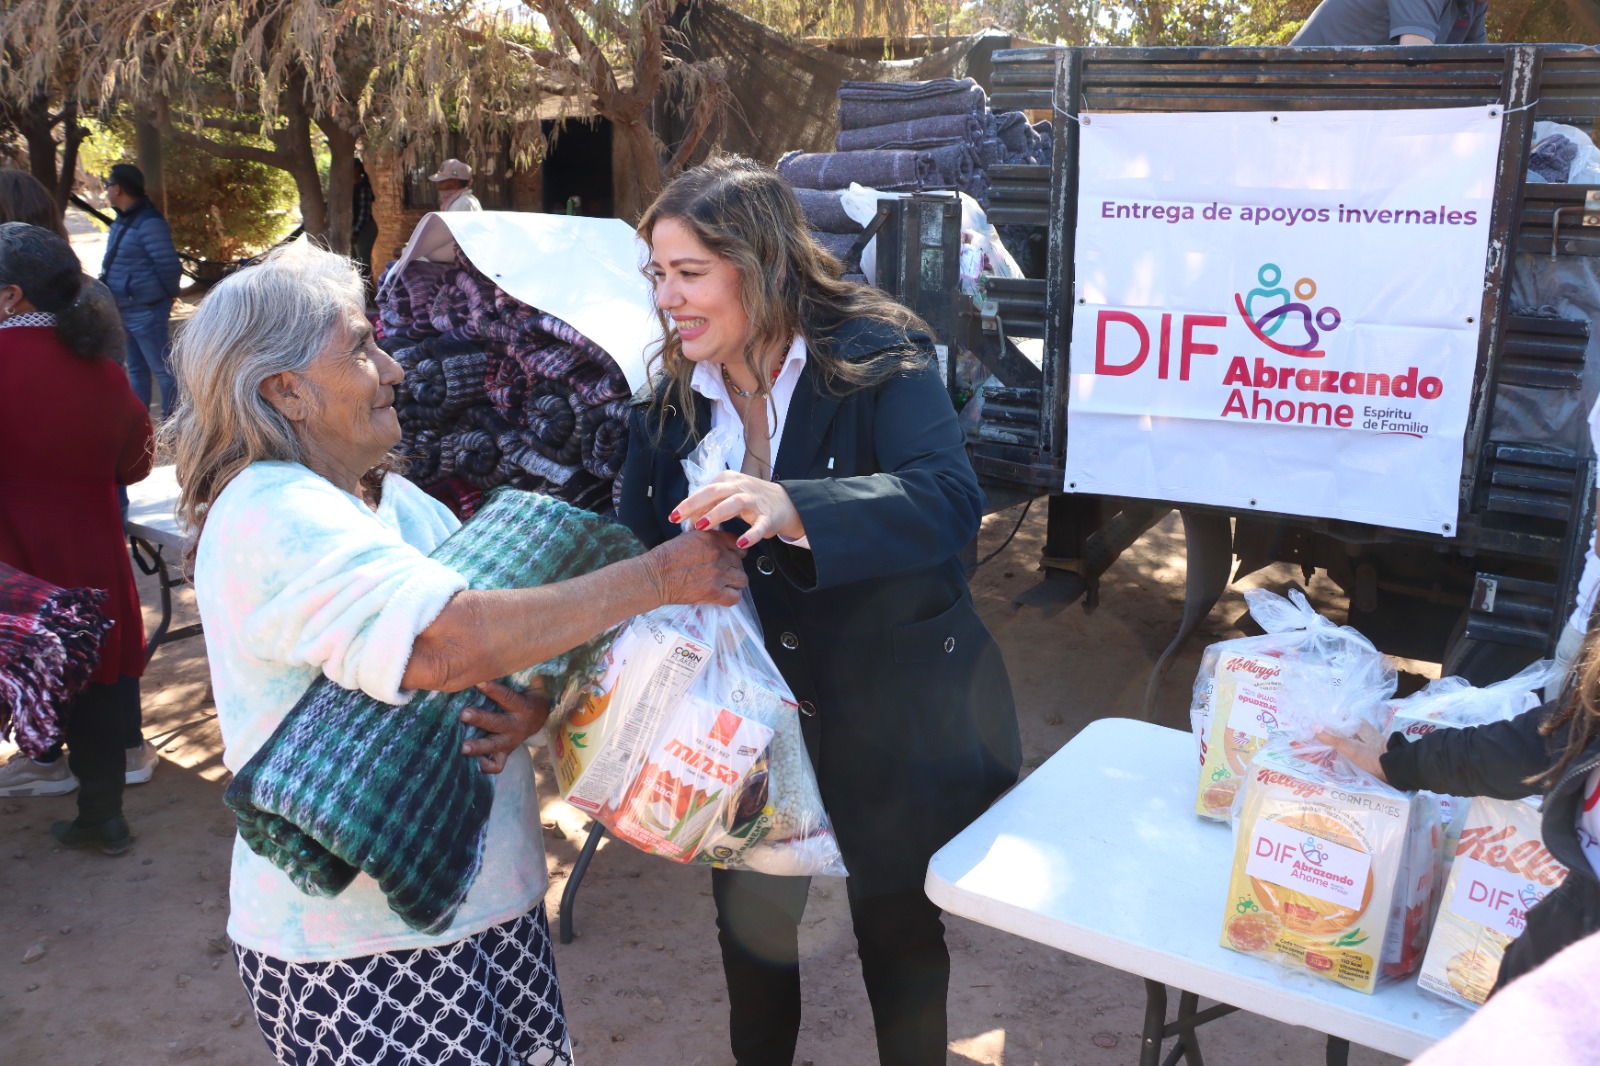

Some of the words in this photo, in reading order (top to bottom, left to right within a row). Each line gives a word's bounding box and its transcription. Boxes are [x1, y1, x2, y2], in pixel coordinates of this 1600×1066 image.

[1101, 200, 1195, 224] Entrega
[1202, 202, 1232, 221] de
[1240, 205, 1330, 227] apoyos
[1338, 203, 1478, 226] invernales
[1094, 309, 1228, 381] DIF
[1222, 355, 1444, 400] Abrazando
[1220, 388, 1355, 428] Ahome
[1363, 405, 1412, 421] Espíritu
[1362, 418, 1379, 431] de
[1380, 420, 1429, 435] Familia
[671, 653, 698, 669] FLAKES
[675, 647, 702, 663] CORN
[1226, 657, 1282, 680] Kellogg's
[1238, 694, 1278, 714] brazando
[664, 738, 741, 786] minsa
[1330, 791, 1361, 806] CORN
[1362, 800, 1401, 818] FLAKES
[1256, 837, 1297, 864] DIF
[1290, 869, 1329, 888] Ahome
[1292, 860, 1354, 886] Abrazando
[1468, 880, 1514, 911] DIF
